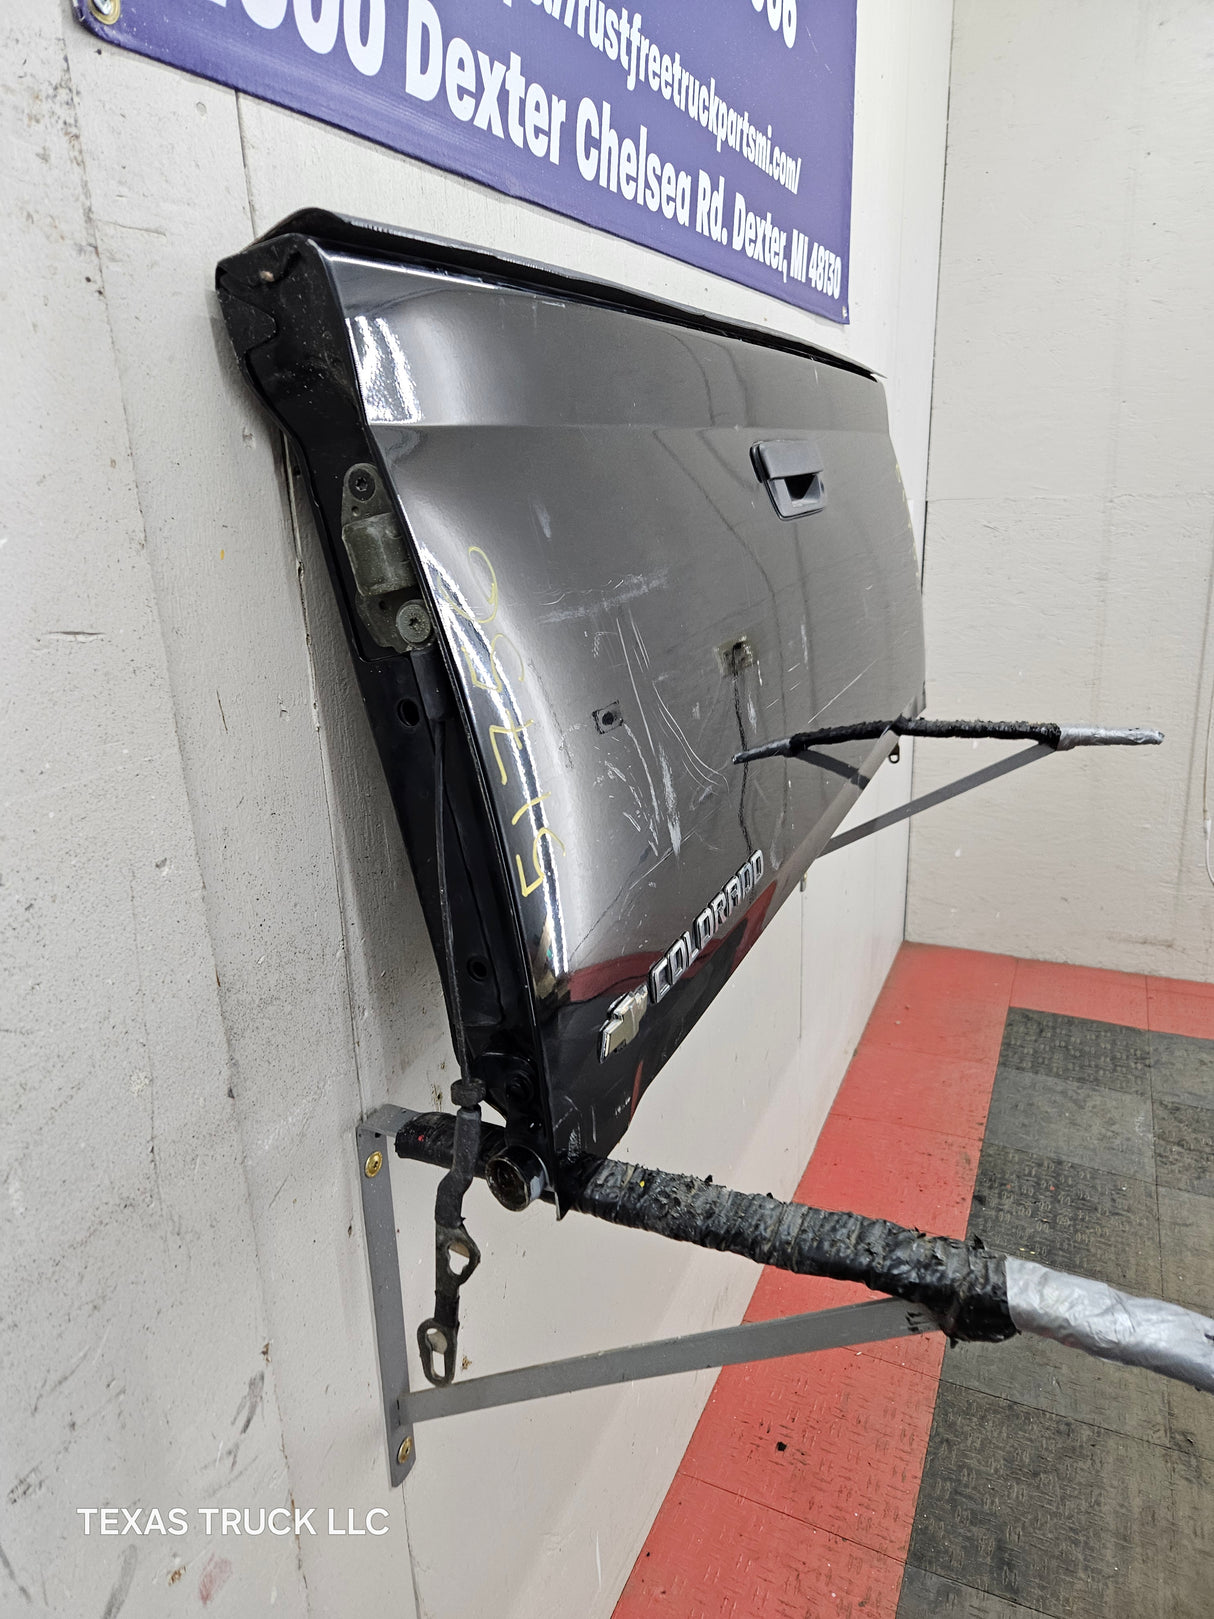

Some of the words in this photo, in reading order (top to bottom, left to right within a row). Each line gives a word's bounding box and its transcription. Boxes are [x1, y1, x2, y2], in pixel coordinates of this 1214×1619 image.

[405, 0, 566, 165] Dexter
[576, 97, 692, 227] Chelsea
[695, 169, 728, 246] Rd.
[732, 192, 788, 283] Dexter,
[789, 229, 808, 283] MI
[808, 241, 842, 300] 48130
[648, 849, 765, 1004] COLORADO
